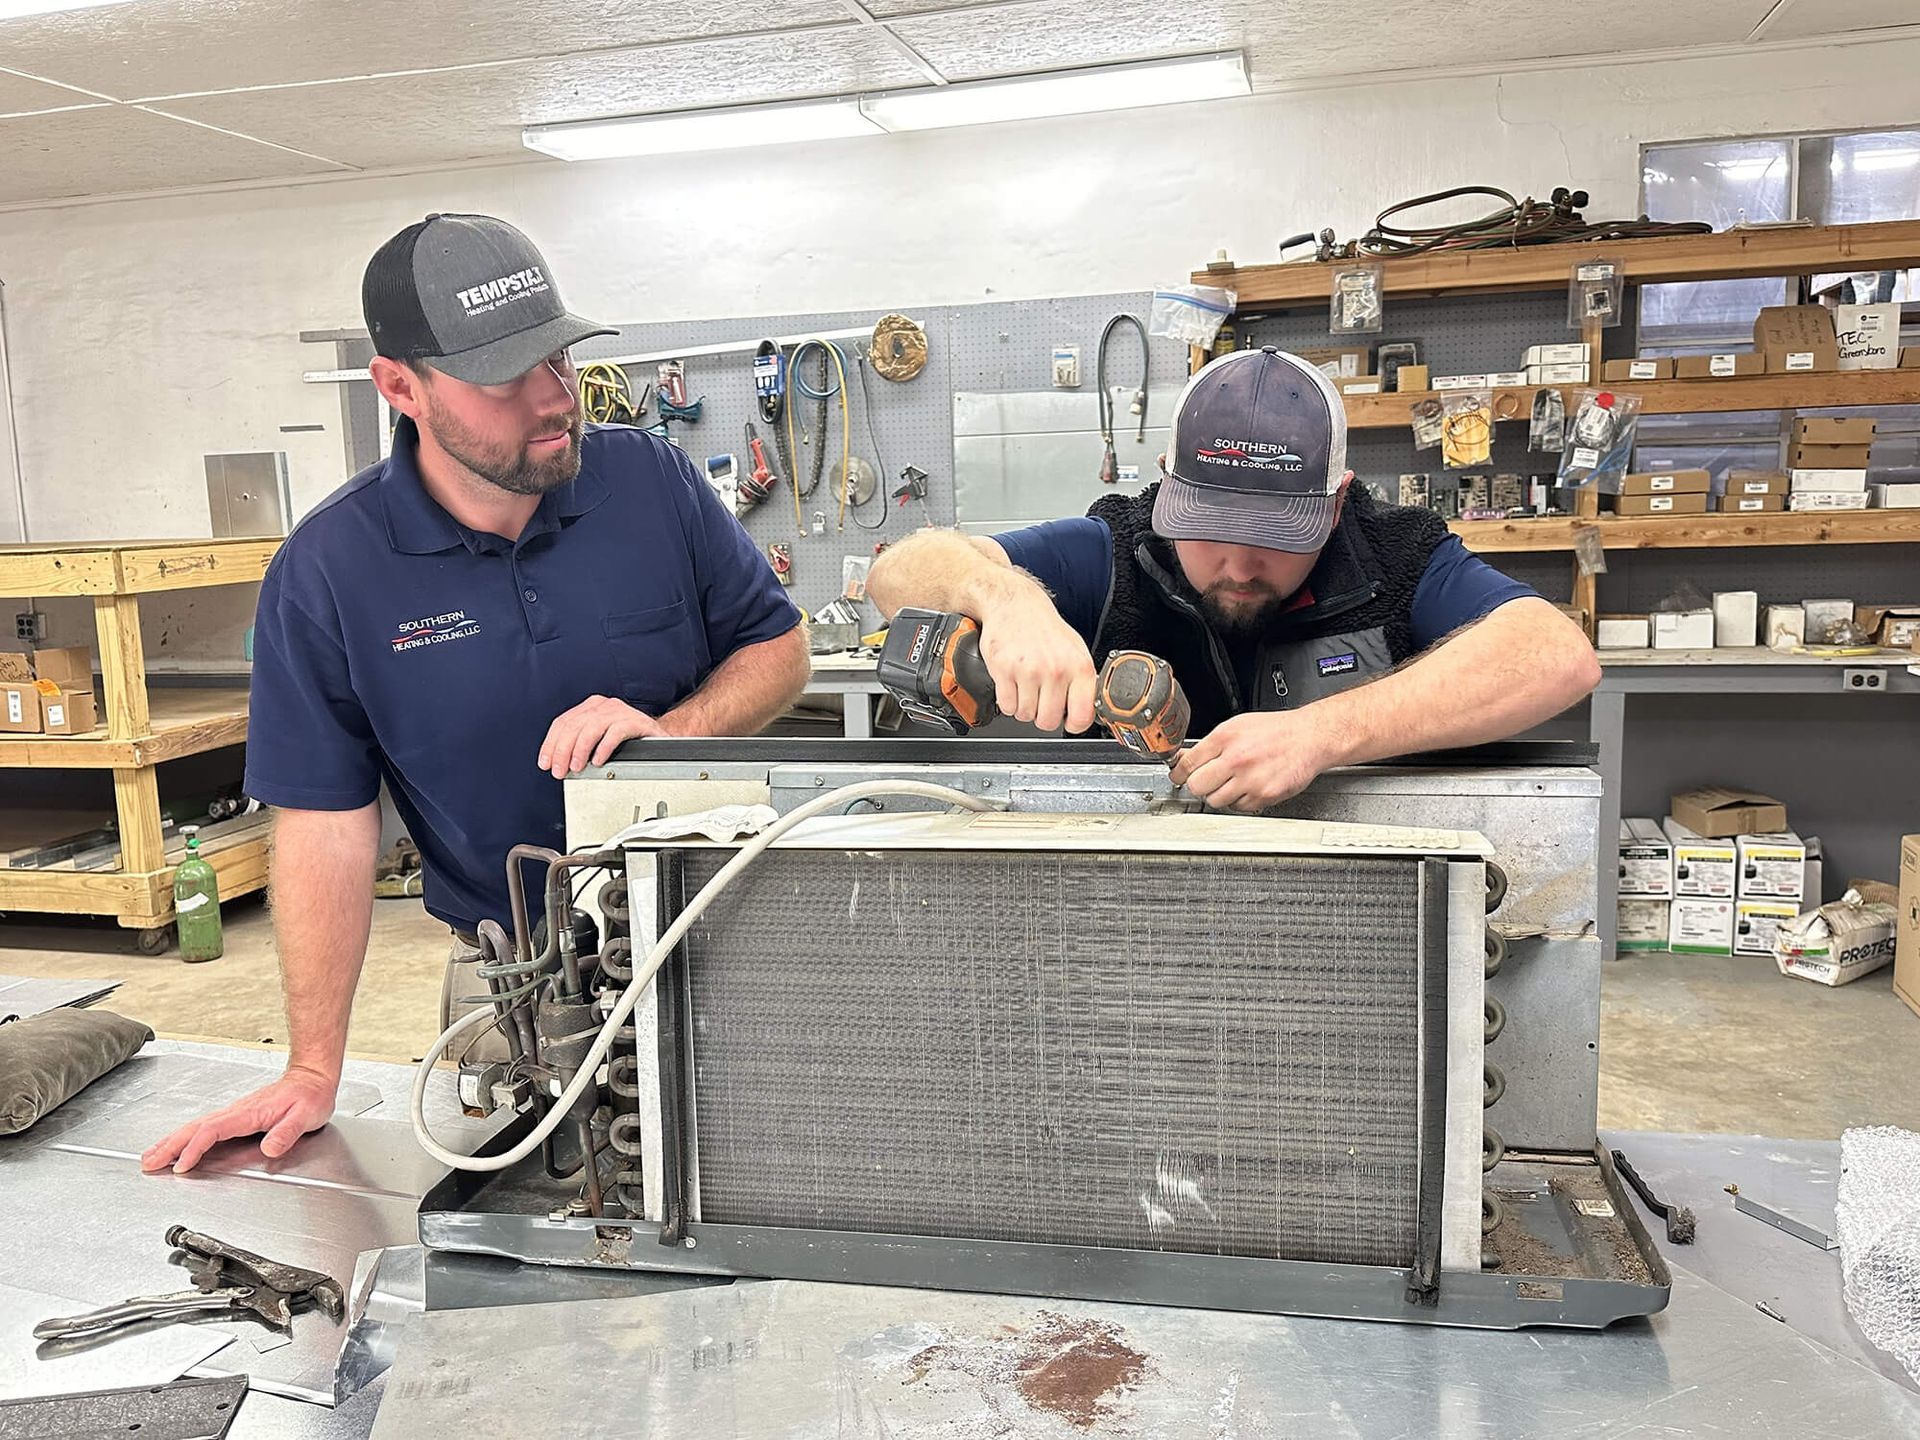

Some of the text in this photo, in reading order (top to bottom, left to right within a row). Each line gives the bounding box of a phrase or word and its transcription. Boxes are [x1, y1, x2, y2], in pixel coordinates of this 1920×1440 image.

[465, 303, 495, 317] Heating
[495, 297, 508, 307] and
[1838, 343, 1886, 359] Greensboro
[1214, 438, 1287, 454] SOUTHERN
[1196, 453, 1303, 472] HEATING & COOLING, LLC
[398, 610, 465, 632] SOUTHERN
[392, 625, 481, 652] HEATING & COOLING, LLC
[910, 624, 930, 664] RIDGID
[1321, 662, 1354, 675] patagonia
